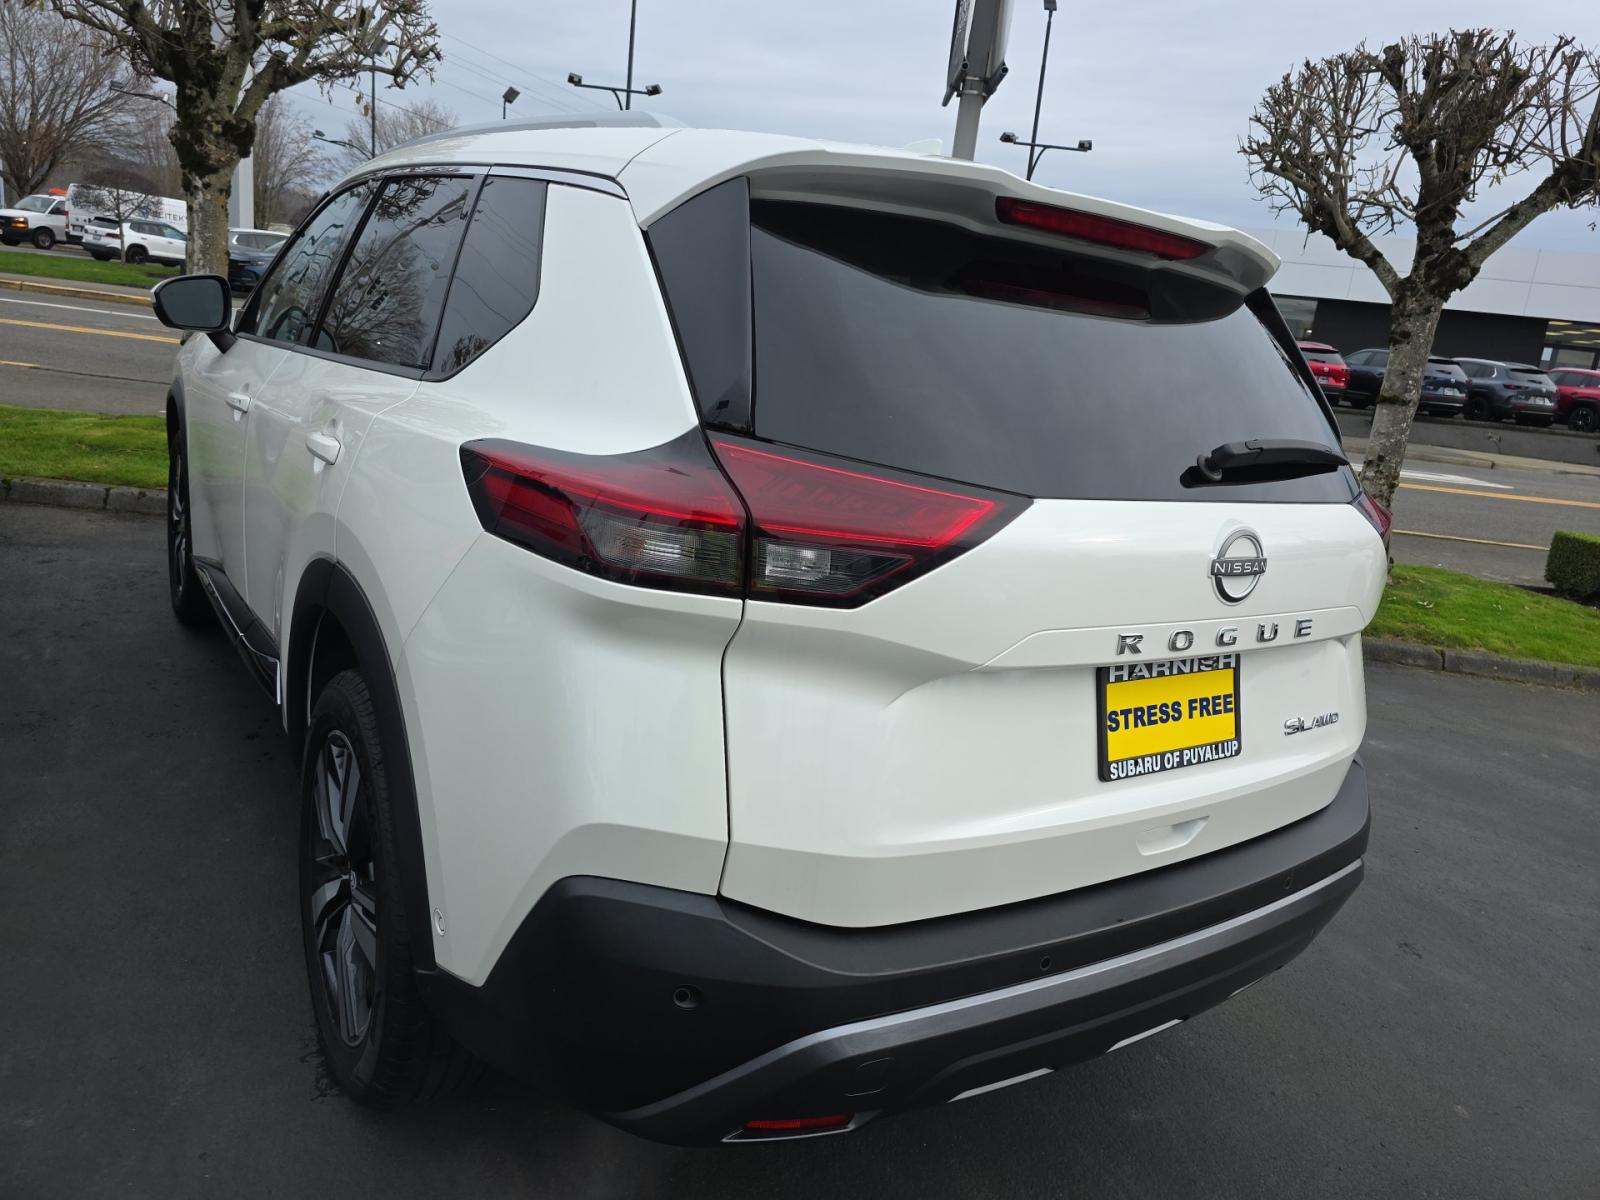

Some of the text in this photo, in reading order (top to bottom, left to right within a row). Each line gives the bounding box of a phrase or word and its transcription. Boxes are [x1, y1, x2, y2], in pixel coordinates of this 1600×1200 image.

[1214, 561, 1266, 574] NISSAN
[1117, 619, 1312, 655] ROGUE
[1109, 654, 1236, 682] HARNISH
[1108, 694, 1233, 732] STRESS FREE
[1284, 712, 1338, 736] SL AWD
[1110, 740, 1238, 779] SUBARU OF PUYALLUP
